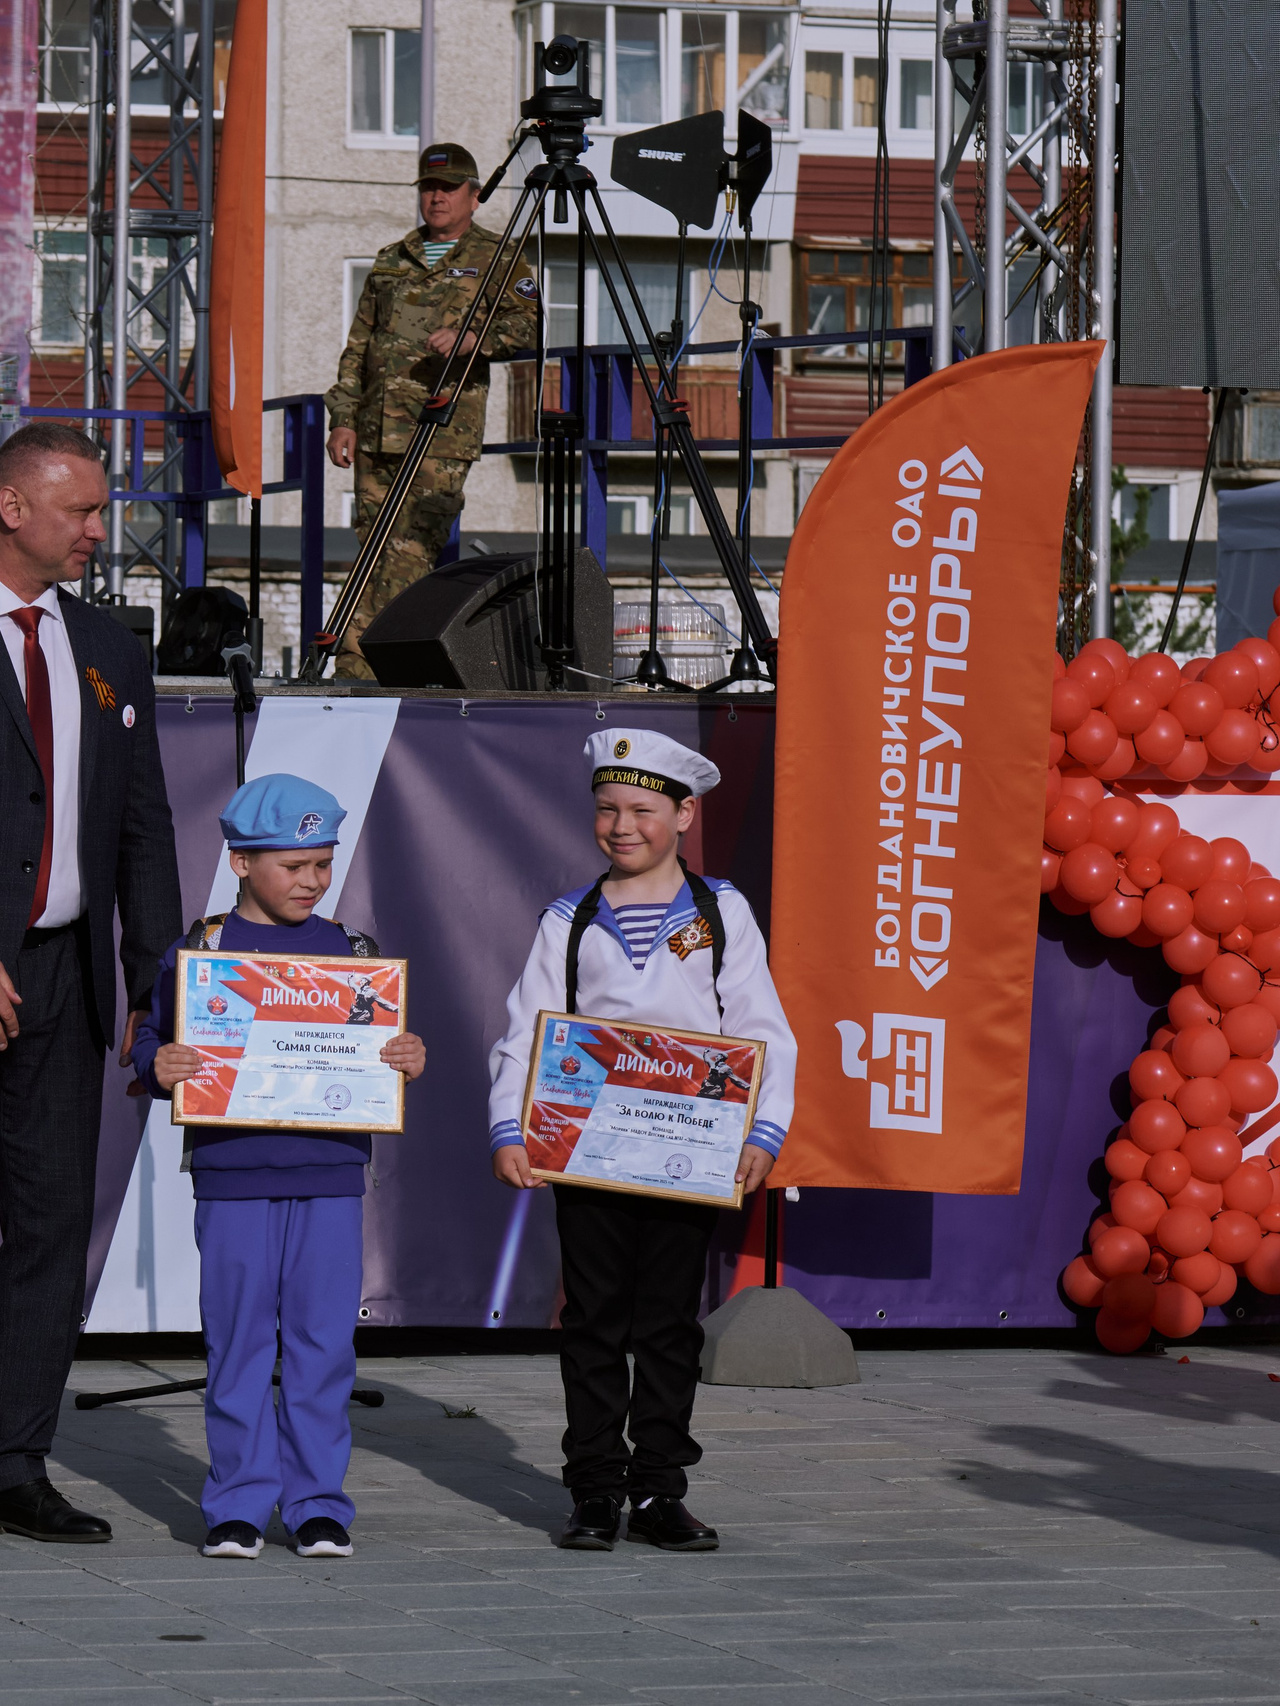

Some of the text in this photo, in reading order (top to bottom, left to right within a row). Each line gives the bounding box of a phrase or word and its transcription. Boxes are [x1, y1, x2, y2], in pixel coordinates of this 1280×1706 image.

[638, 148, 683, 162] SHURE
[874, 459, 928, 968] БОГДАНОВИЧСКОЕ ОАО
[910, 483, 982, 953] ОГНЕУПОРЫ
[640, 775, 665, 791] ФЛОТ
[261, 988, 340, 1007] ДИПЛОМ
[294, 1031, 345, 1040] НАГРАЖДАЕТСЯ
[614, 1053, 694, 1080] ДИПЛОМ
[643, 1098, 694, 1111] НАГРАЖДАЕТСЯ
